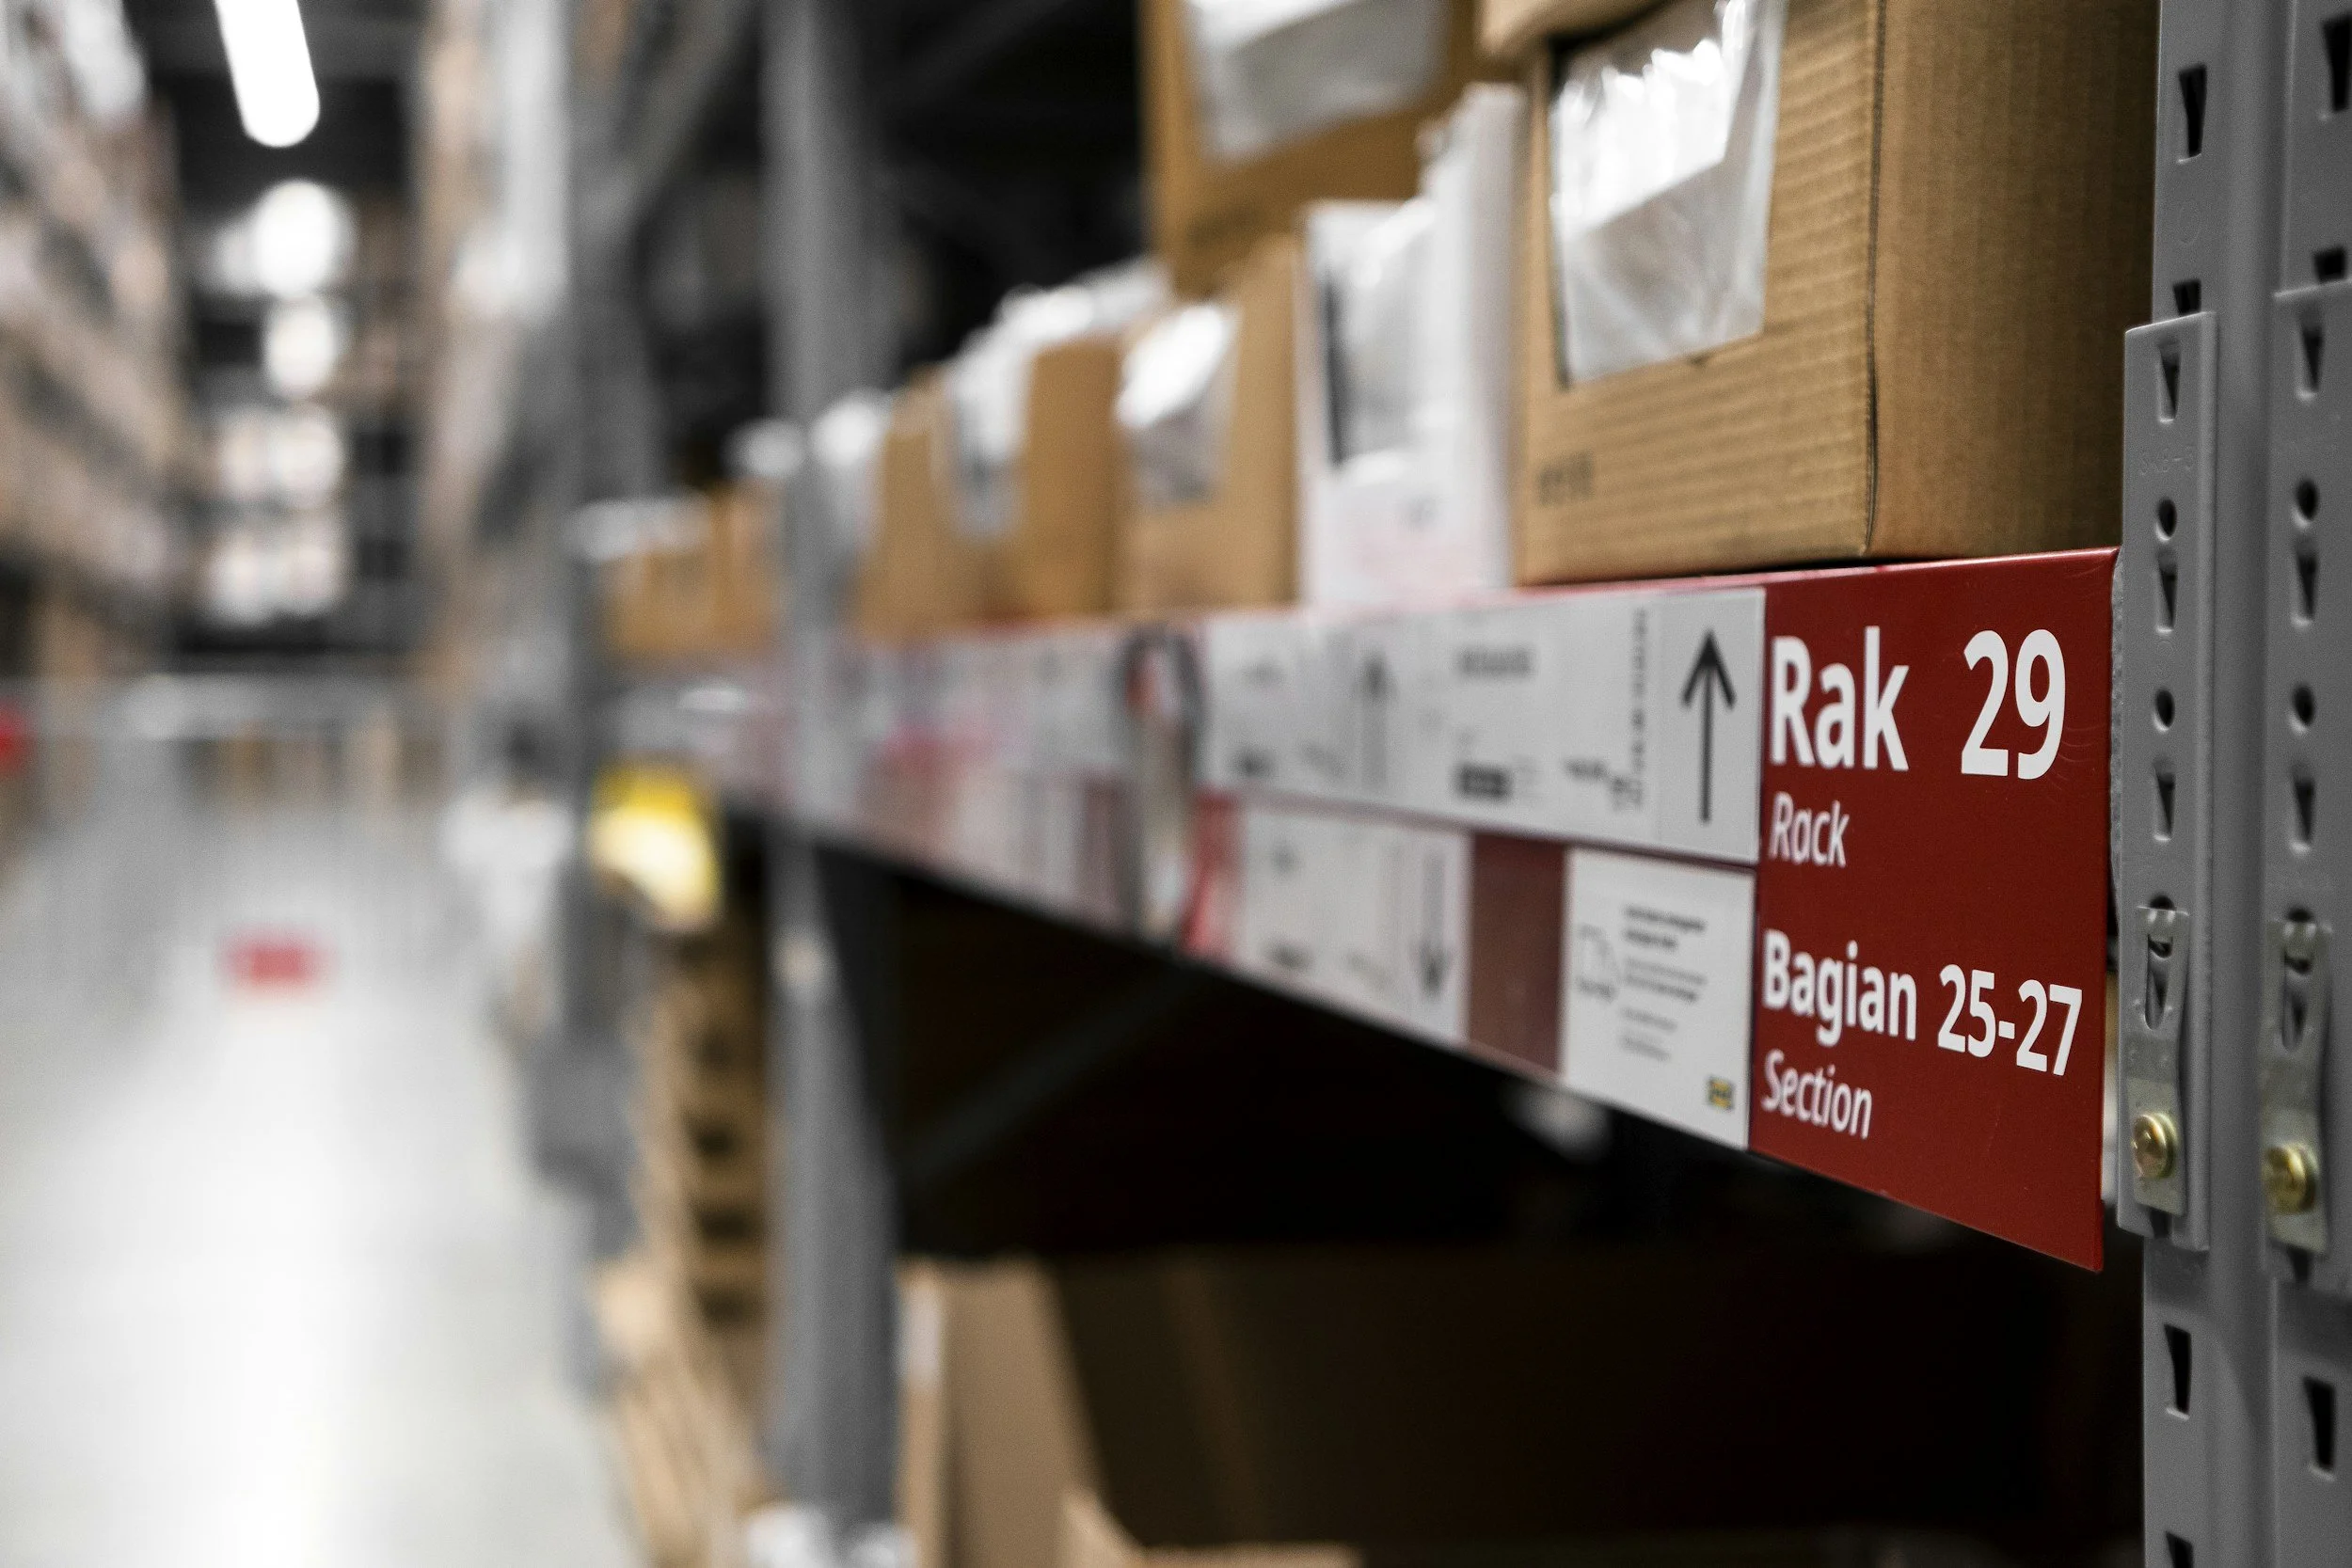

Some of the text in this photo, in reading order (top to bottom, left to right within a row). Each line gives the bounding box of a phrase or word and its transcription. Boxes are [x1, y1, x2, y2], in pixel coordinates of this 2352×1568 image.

[1770, 626, 1910, 771] Rak
[1961, 628, 2066, 780] 29
[1769, 791, 1850, 867] Rack
[1762, 928, 2083, 1076] Bagian 25-27
[1761, 1049, 1873, 1140] Section
